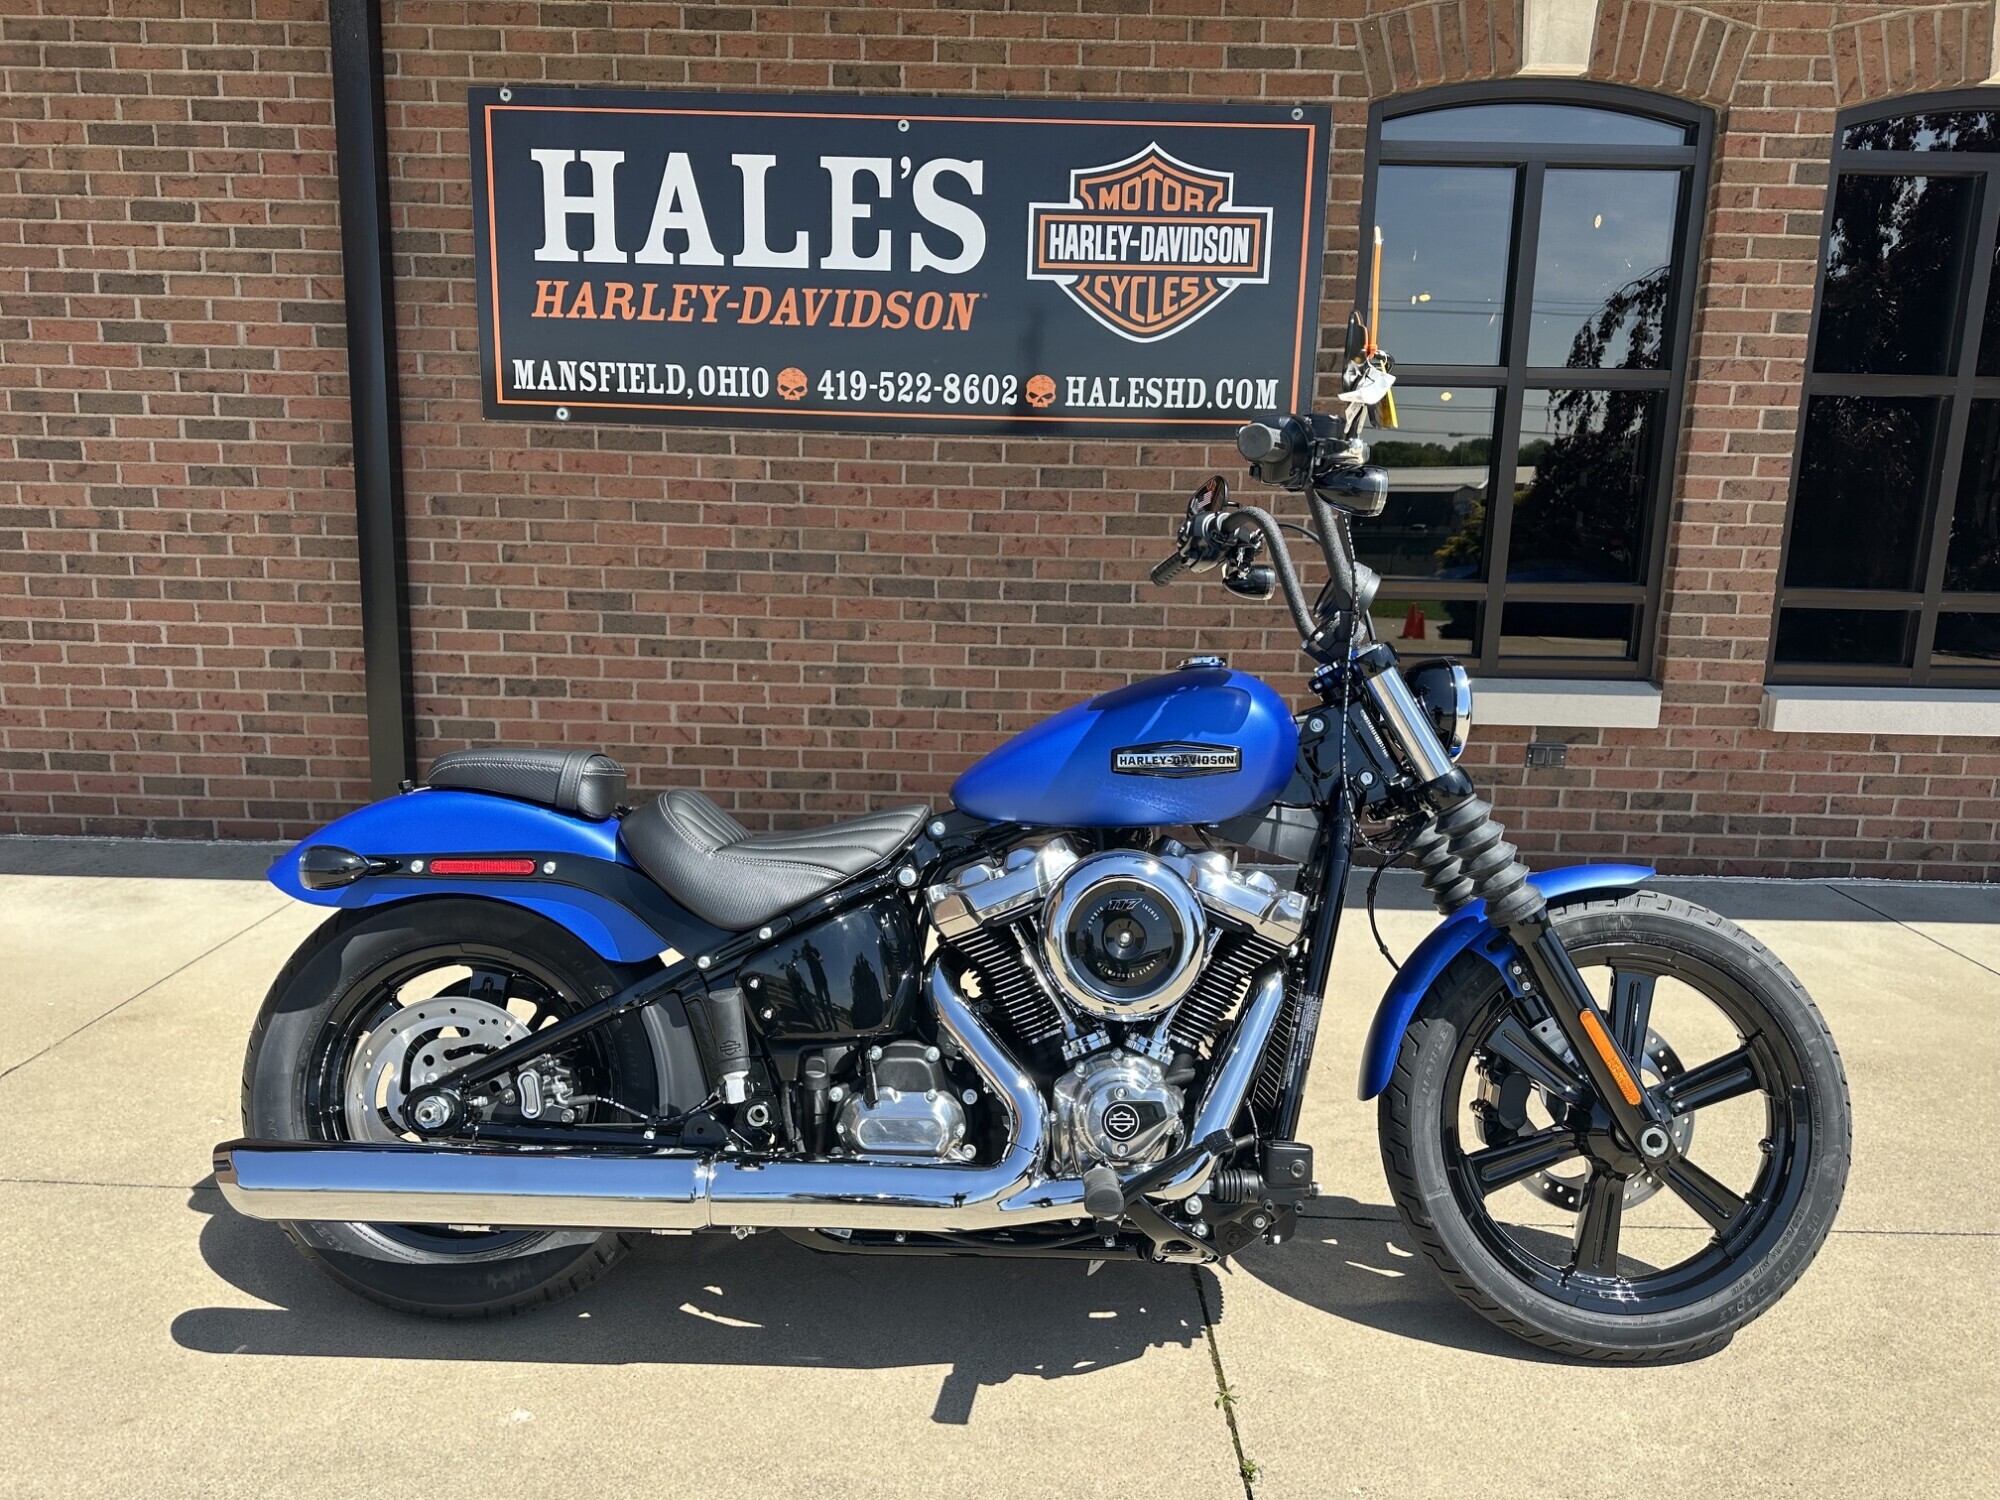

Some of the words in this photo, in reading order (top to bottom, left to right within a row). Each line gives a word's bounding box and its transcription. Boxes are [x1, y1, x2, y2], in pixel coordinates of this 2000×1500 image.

[530, 148, 987, 275] HALE'S
[1099, 168, 1205, 212] MOTOR
[1049, 224, 1250, 264] HARLEY-DAVIDSON
[531, 280, 980, 331] HARLEY-DAVIDSON
[1094, 275, 1200, 324] CYCLES
[817, 369, 1018, 405] 419-522-8602
[1065, 376, 1279, 410] HALESHD.COM
[1119, 755, 1235, 766] HARLEY-DAVIDSON
